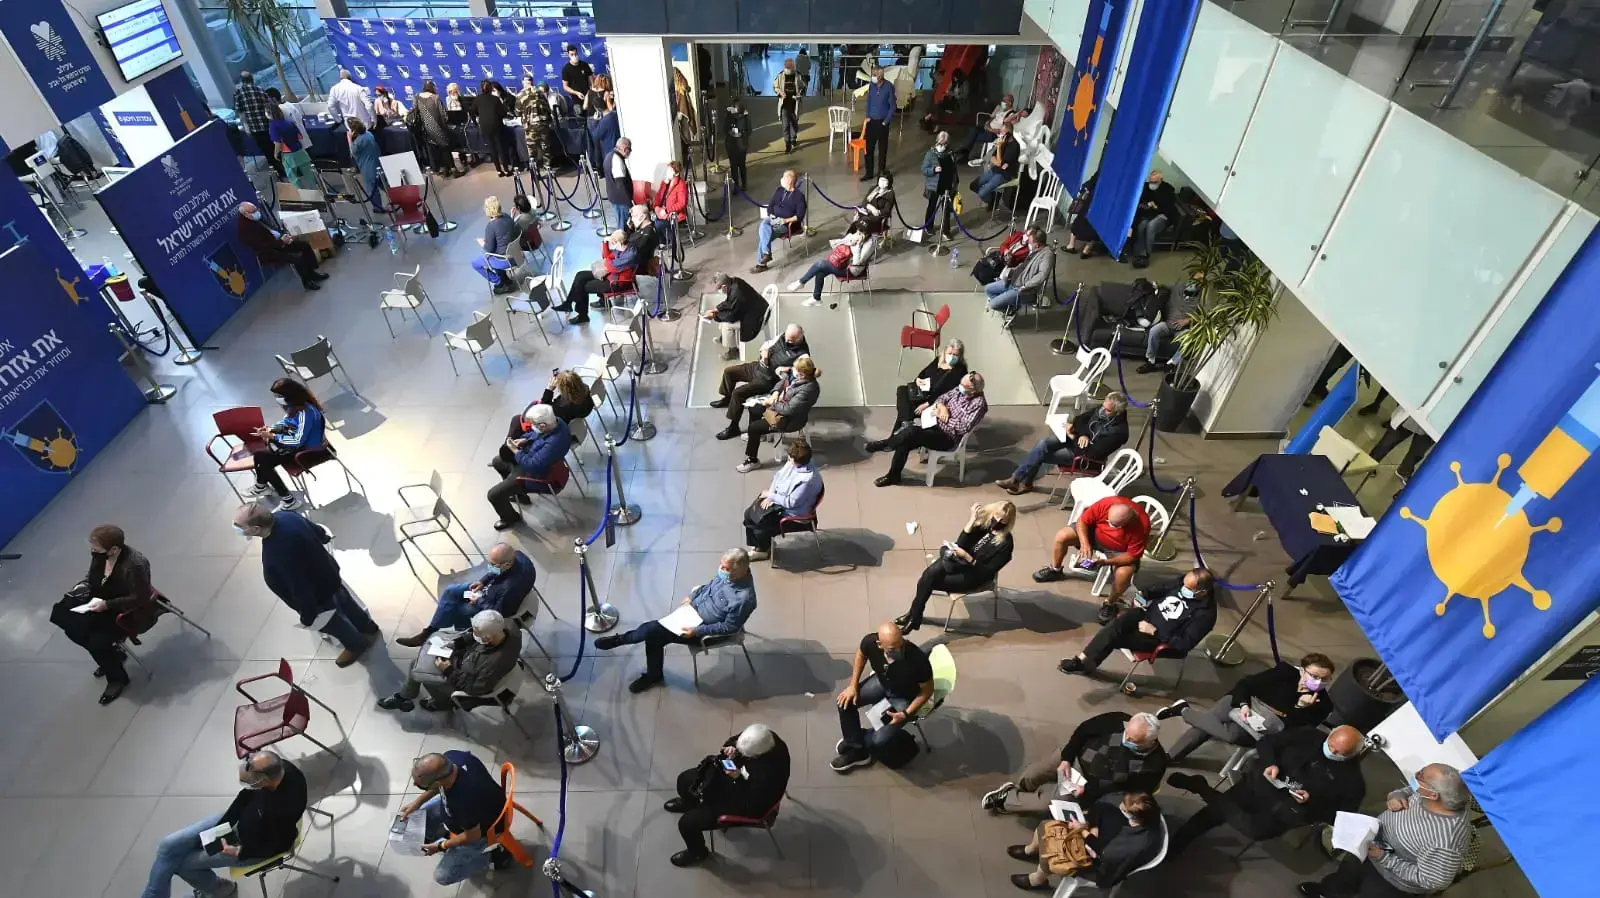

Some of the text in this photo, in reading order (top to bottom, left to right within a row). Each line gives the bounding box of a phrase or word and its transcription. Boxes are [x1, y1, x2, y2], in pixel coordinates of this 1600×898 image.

[156, 188, 238, 254] את אזרחי ישראל
[32, 328, 64, 358] את
[46, 346, 72, 367] ומחזיר
[34, 365, 49, 380] את
[2, 375, 37, 406] הבריאות
